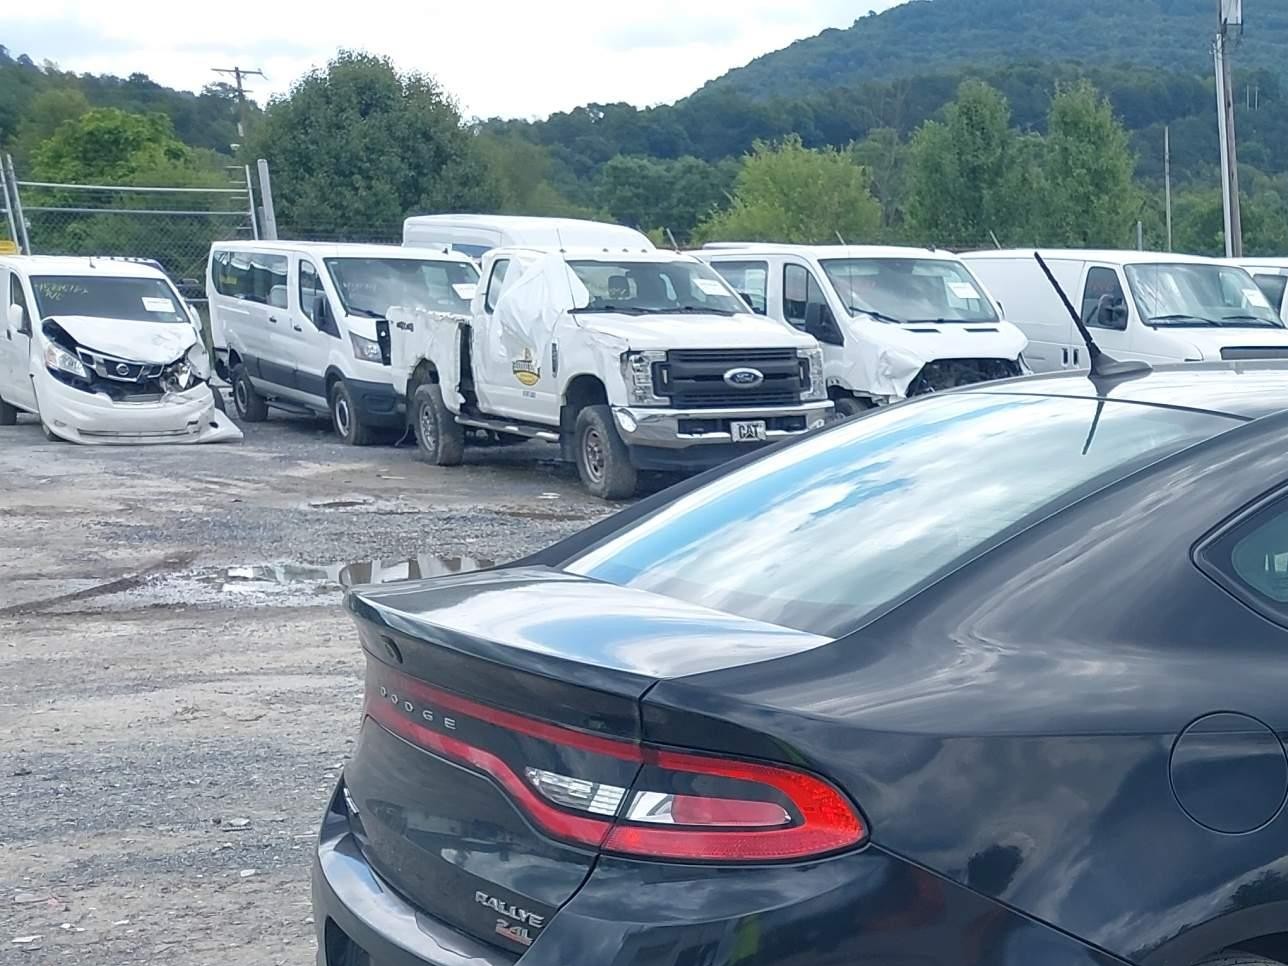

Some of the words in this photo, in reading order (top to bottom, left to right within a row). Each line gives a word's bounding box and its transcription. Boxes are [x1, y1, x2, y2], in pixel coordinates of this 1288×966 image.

[737, 423, 759, 440] CAT
[380, 686, 456, 730] DODGE
[475, 890, 545, 928] RALLYE
